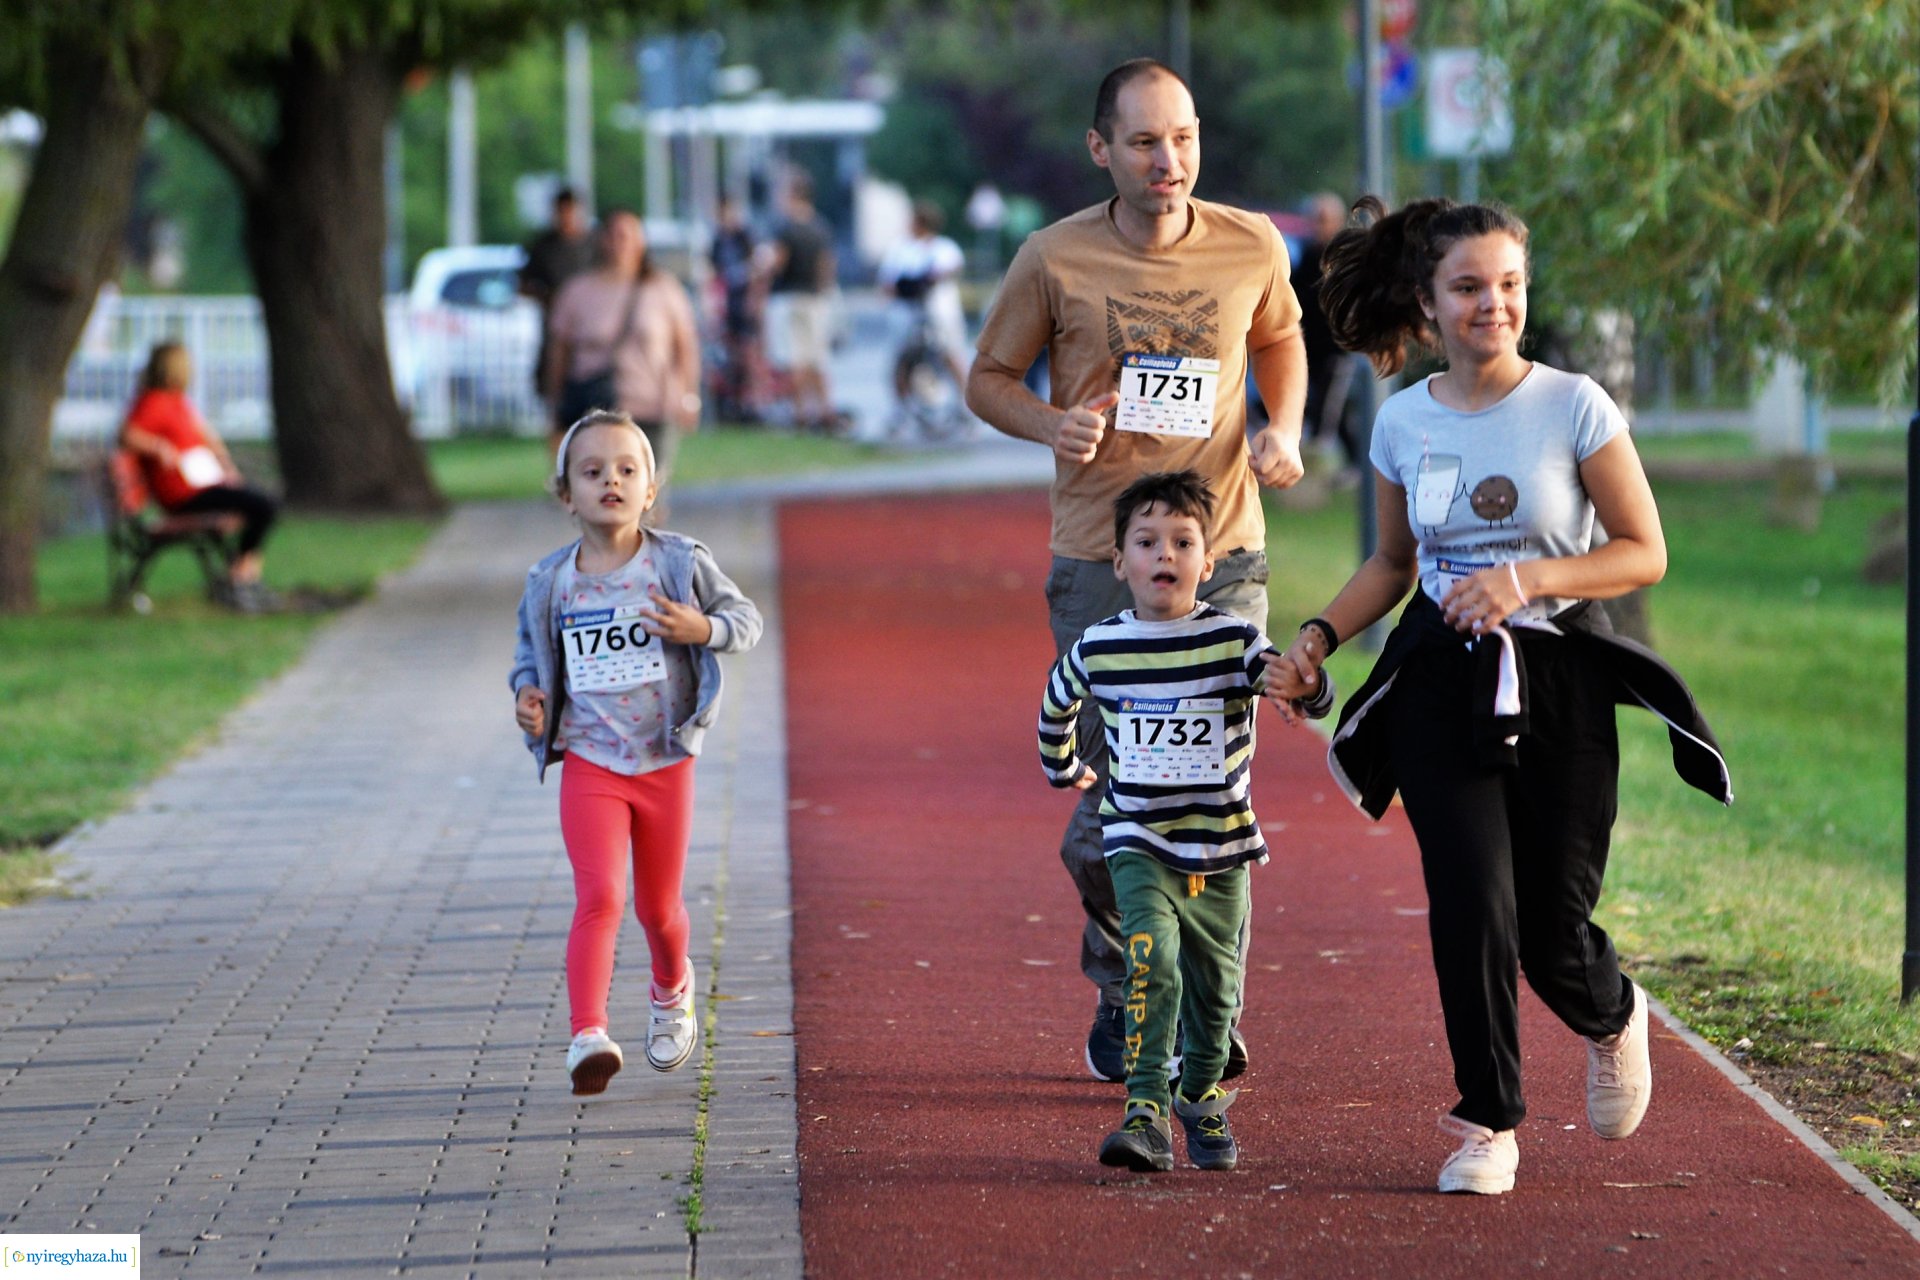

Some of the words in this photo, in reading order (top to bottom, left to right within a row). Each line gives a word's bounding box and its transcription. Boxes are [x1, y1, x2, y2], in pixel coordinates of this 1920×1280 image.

[1137, 372, 1203, 401] 1731
[571, 622, 651, 656] 1760
[1133, 701, 1174, 712] Csillagfutás
[1130, 717, 1212, 746] 1732
[1126, 932, 1153, 1024] CAMP
